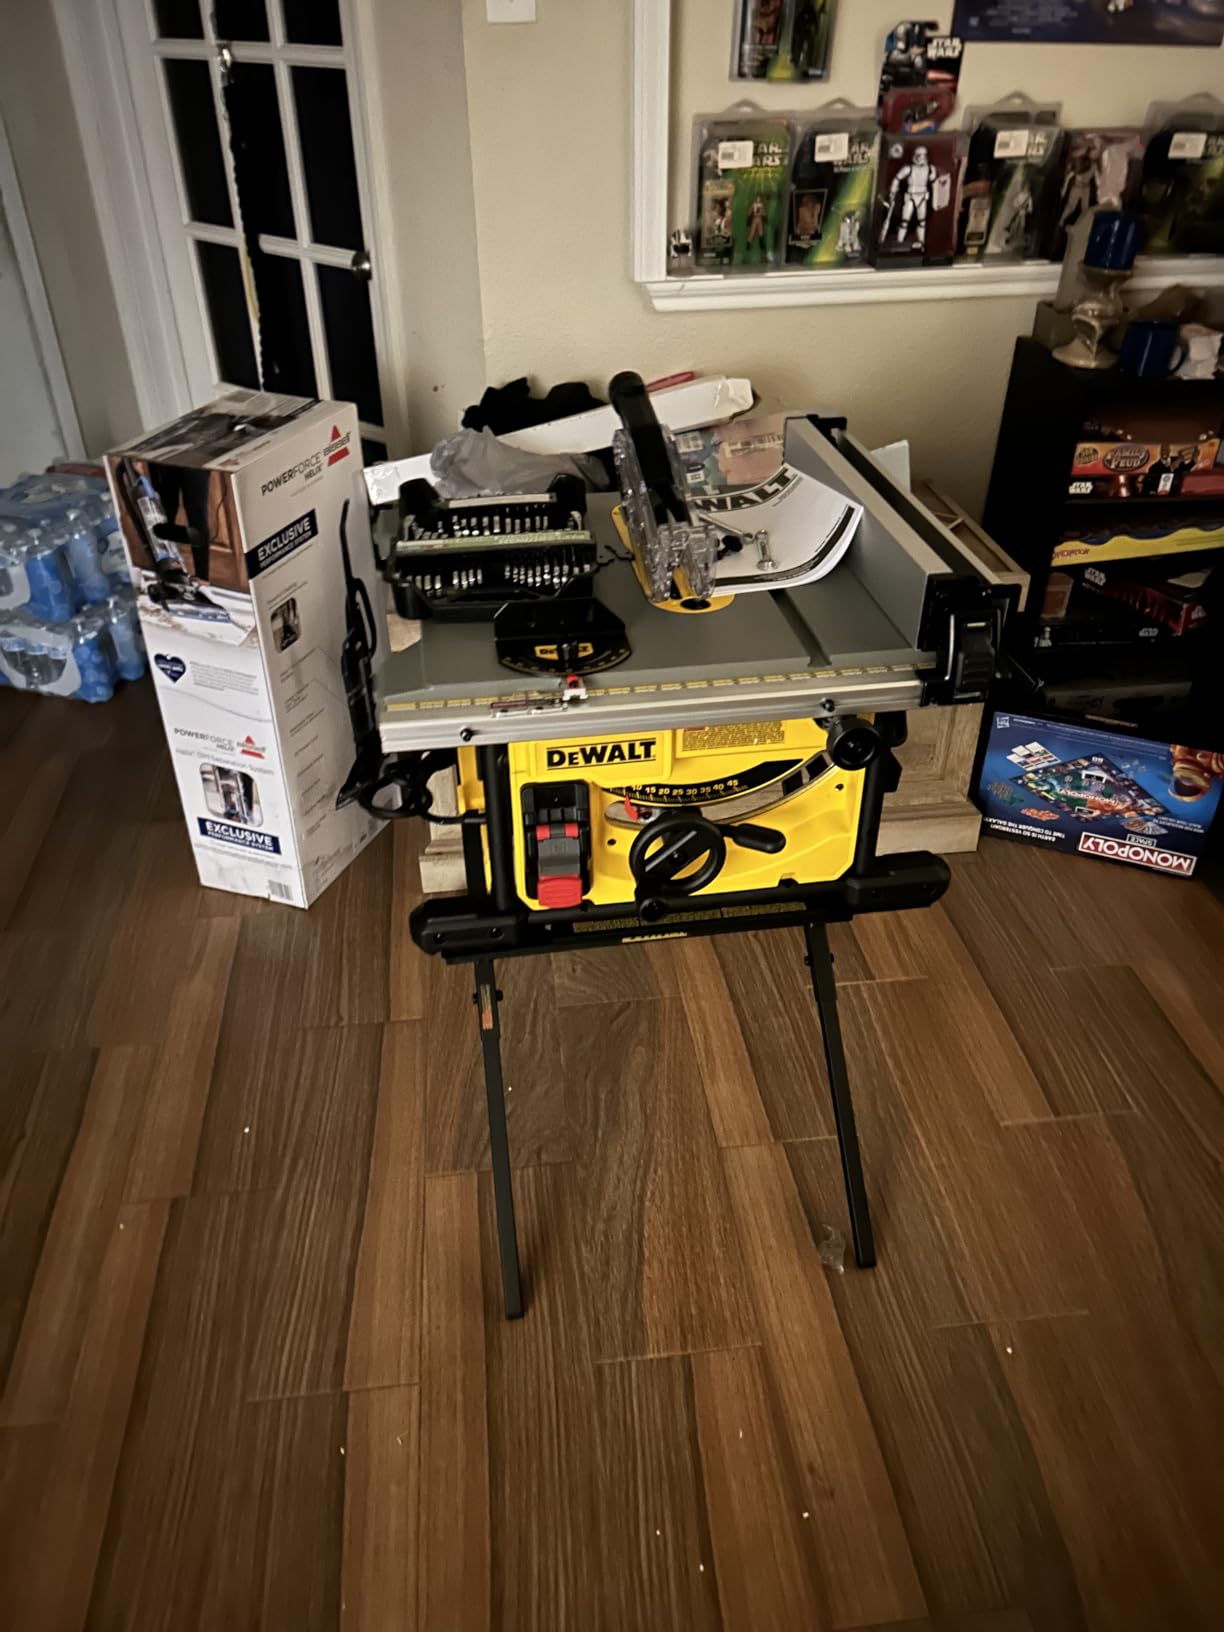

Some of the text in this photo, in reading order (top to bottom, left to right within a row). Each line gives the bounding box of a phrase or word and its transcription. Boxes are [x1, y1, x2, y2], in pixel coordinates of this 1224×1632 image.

[261, 452, 321, 496] POWERFORCE
[1111, 460, 1141, 469] FEUD
[695, 467, 793, 512] WALT
[257, 516, 311, 561] EXCLUSIVE
[174, 728, 235, 745] POWERFORCE
[547, 740, 656, 768] DEWALT
[645, 786, 656, 794] 15
[658, 787, 670, 795] 20
[672, 788, 684, 796] 25
[686, 788, 698, 796] 30
[700, 786, 711, 794] 35
[712, 783, 724, 791] 40
[727, 779, 739, 787] 45
[205, 821, 273, 846] EXCLUSIVE
[1083, 837, 1191, 871] MONOPOLY
